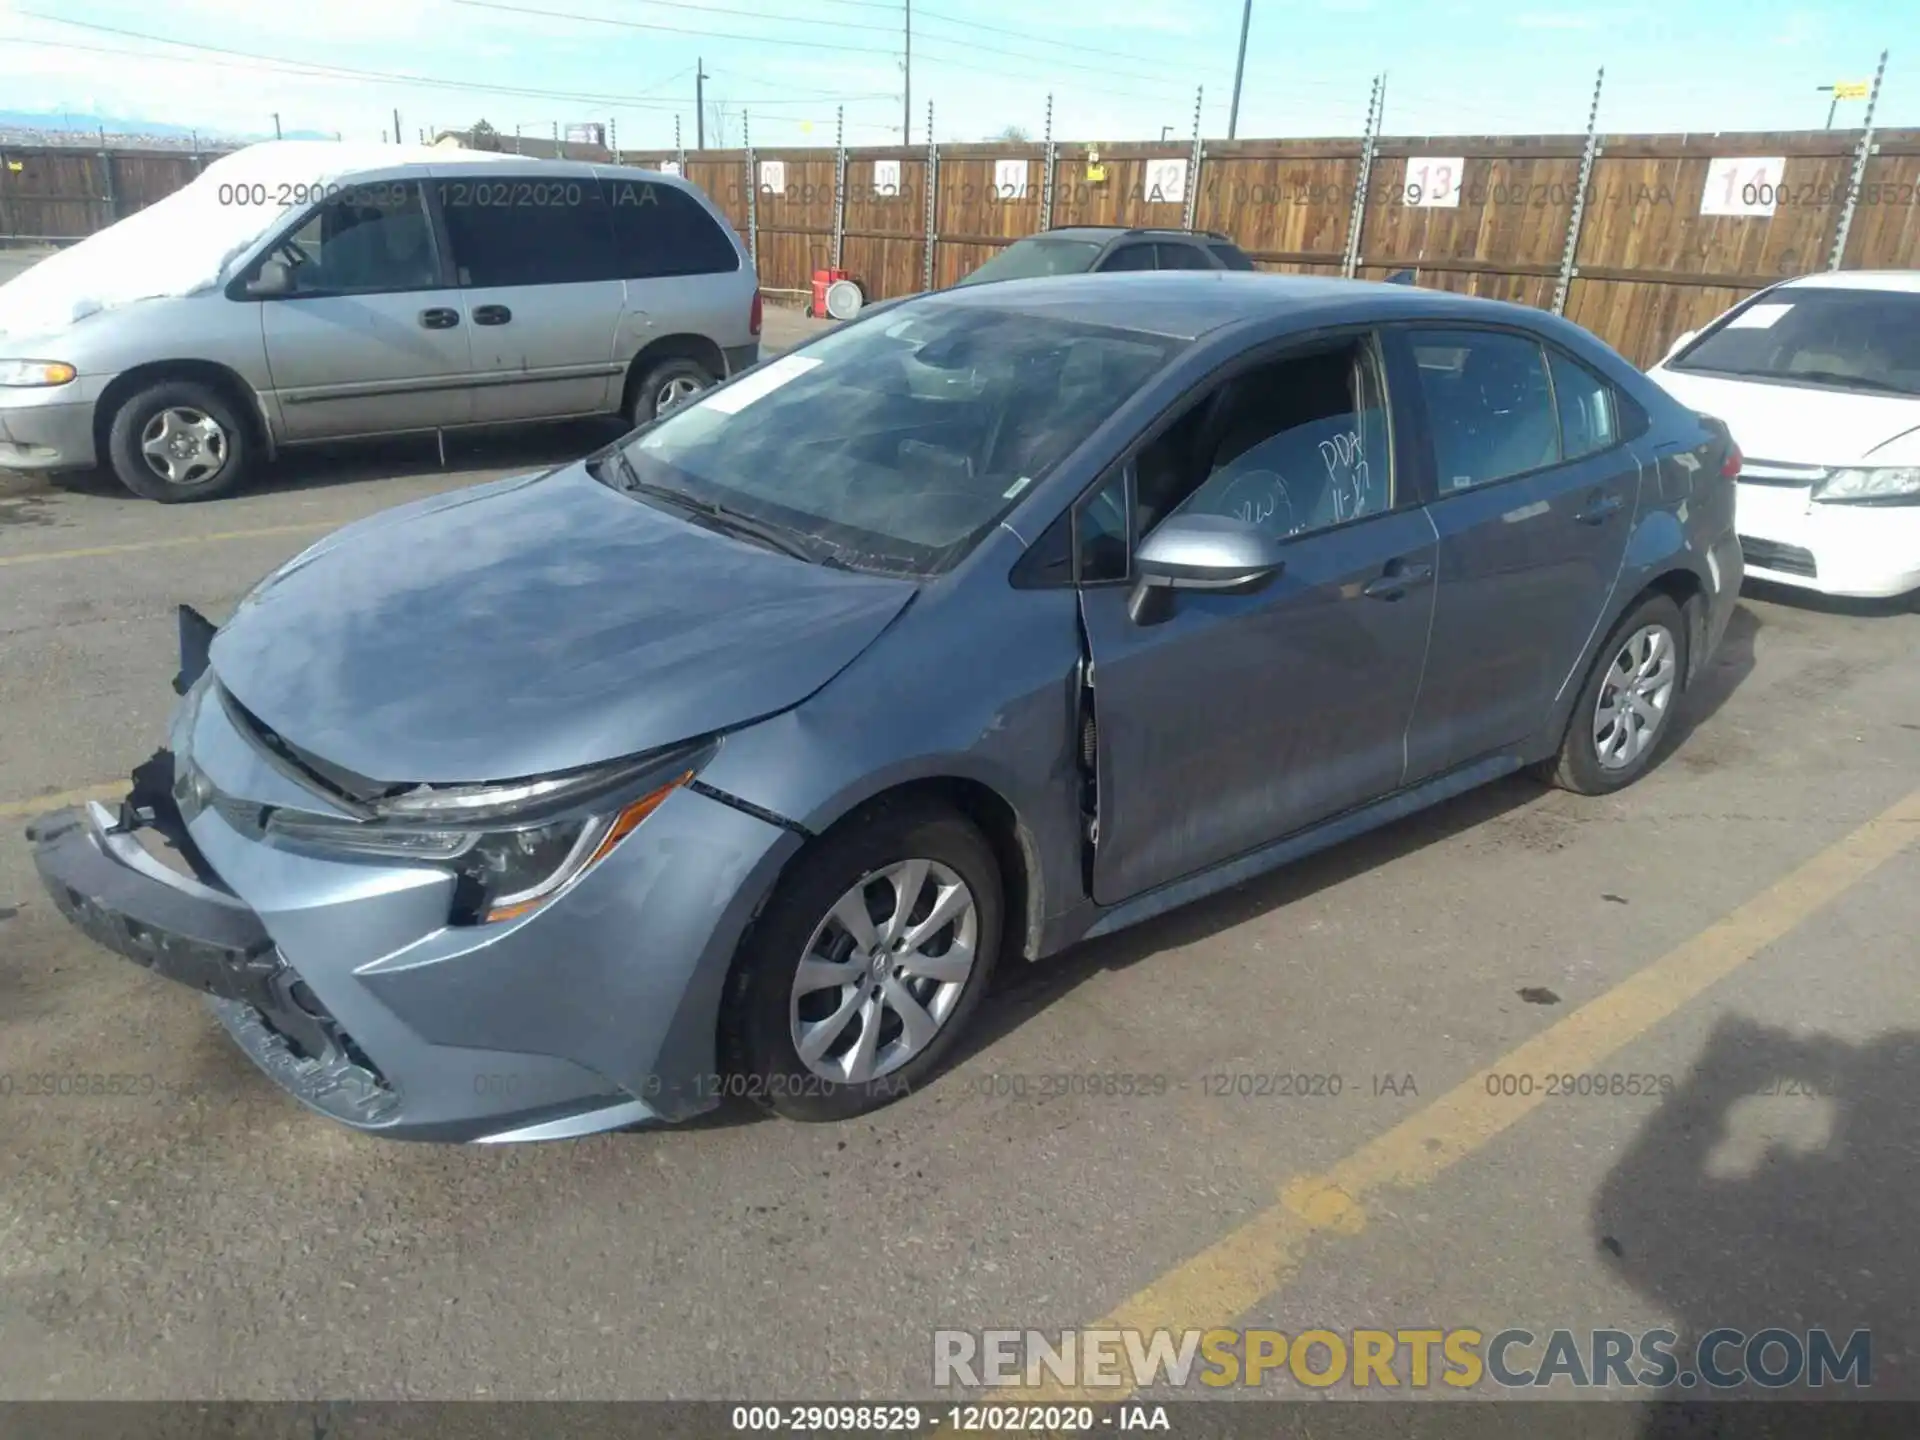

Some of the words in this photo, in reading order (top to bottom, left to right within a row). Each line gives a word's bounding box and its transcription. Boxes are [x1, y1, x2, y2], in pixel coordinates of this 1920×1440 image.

[1154, 164, 1180, 195] 12
[1415, 164, 1452, 199] 13
[1720, 166, 1768, 206] 14
